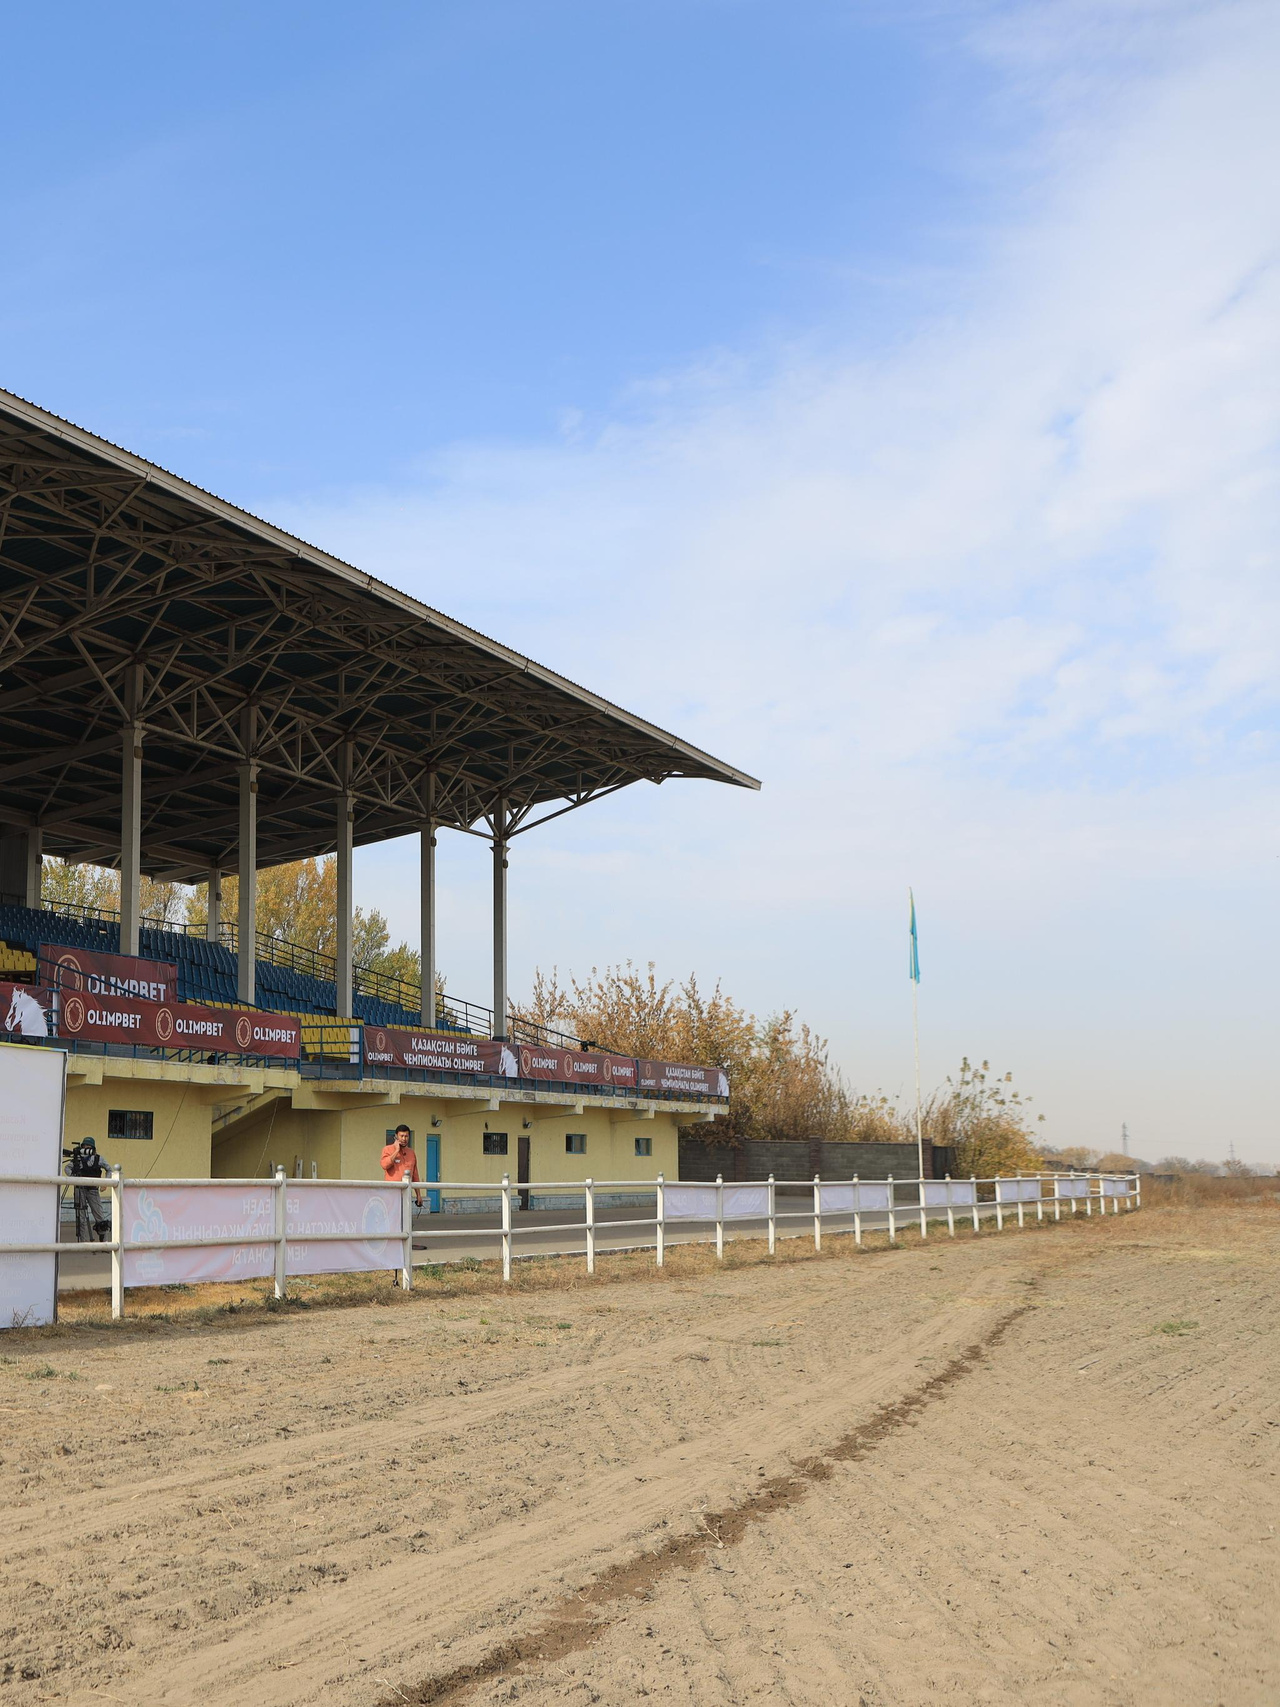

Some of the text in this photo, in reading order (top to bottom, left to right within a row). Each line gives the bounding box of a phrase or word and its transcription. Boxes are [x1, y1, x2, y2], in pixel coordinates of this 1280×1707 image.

[87, 973, 166, 1002] OLIMPBET
[87, 1009, 141, 1028] OLIMPBET
[175, 1018, 223, 1036] OLIMPBET
[253, 1027, 296, 1043] OLIMPBET
[411, 1037, 478, 1056] ҚАЗАҚСТАН БӘЙГЕ
[368, 1052, 394, 1062] OLIMPBET
[403, 1052, 485, 1071] ЧЕМПИОНАТЫ OLIMPBET
[532, 1057, 558, 1069] OLIMPBET
[573, 1062, 598, 1073] OLIMPBET
[612, 1066, 634, 1077] OLIMPBET
